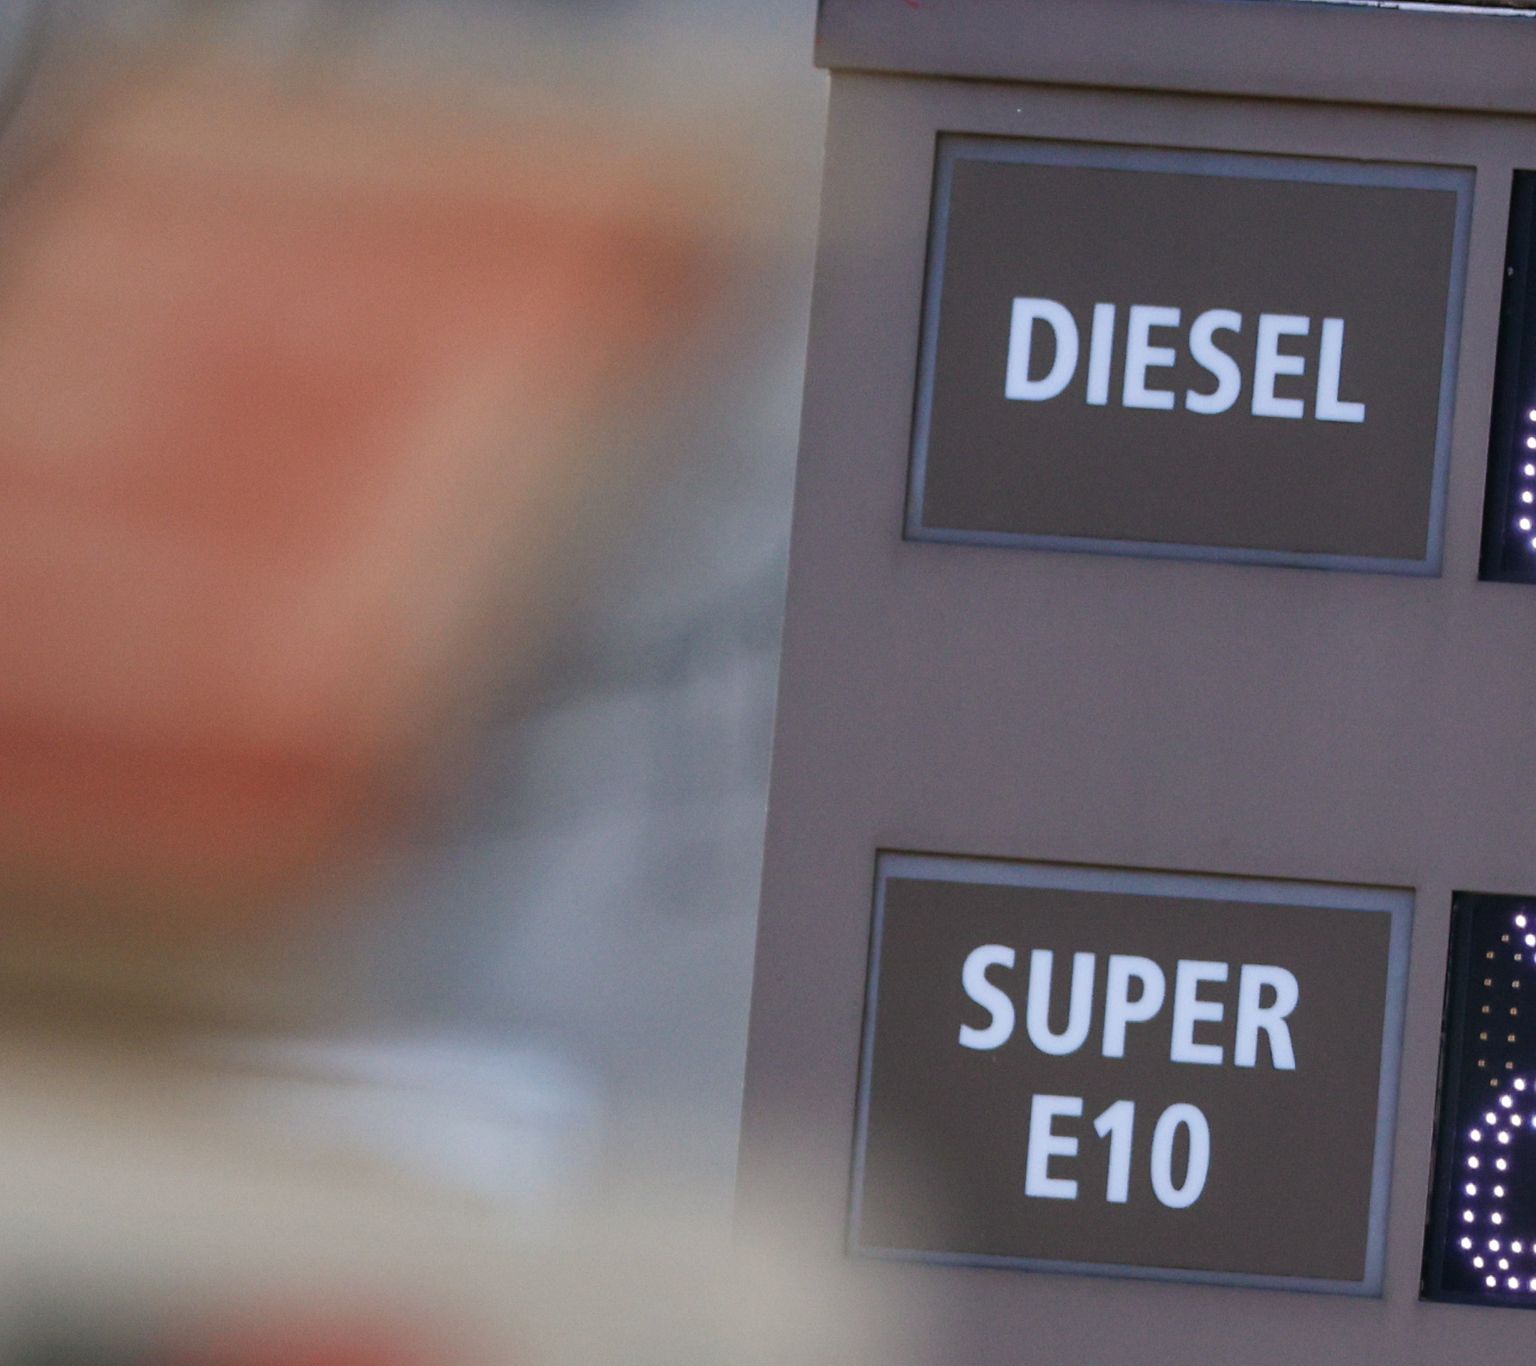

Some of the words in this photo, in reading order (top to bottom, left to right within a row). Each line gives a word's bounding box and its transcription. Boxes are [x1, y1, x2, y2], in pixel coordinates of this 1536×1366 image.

[1004, 297, 1367, 424] DIESEL
[958, 943, 1301, 1070] SUPER
[1025, 1094, 1212, 1209] E10
